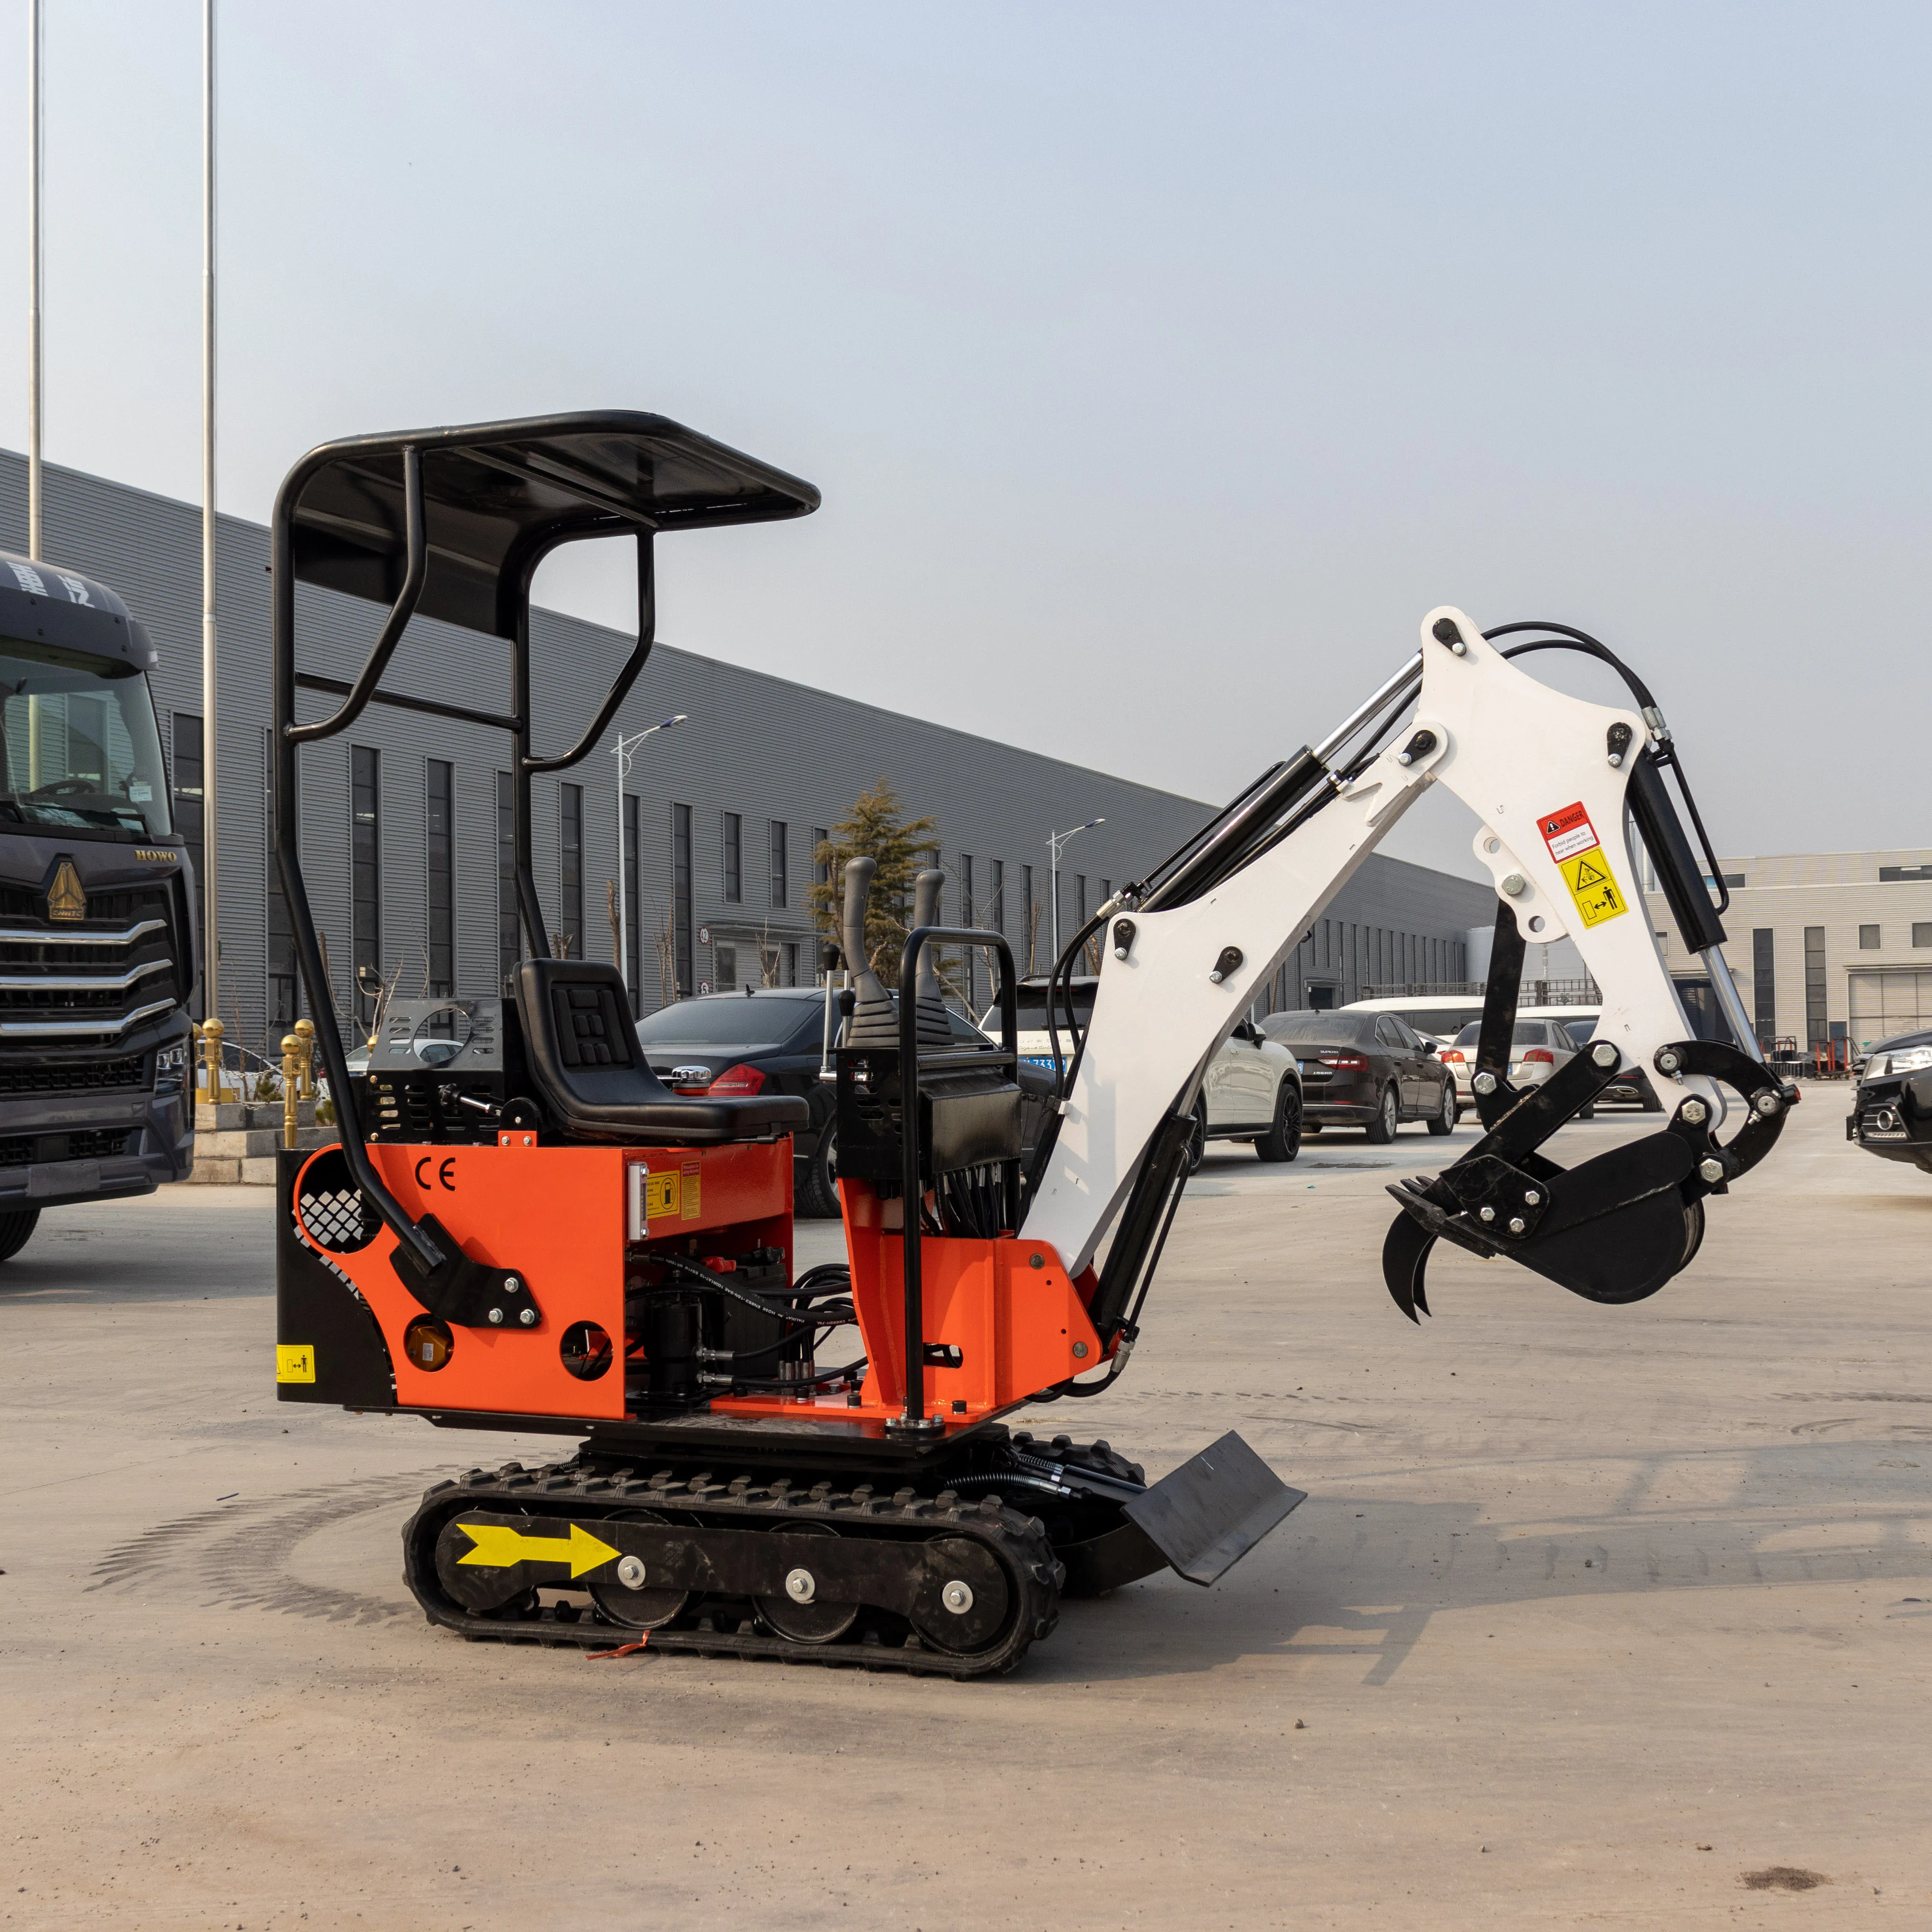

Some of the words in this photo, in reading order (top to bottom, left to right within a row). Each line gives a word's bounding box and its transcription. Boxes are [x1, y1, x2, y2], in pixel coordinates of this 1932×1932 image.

[6, 561, 95, 608] 重汽
[1559, 810, 1584, 826] DANGER
[1552, 840, 1566, 849] Forbid
[1566, 834, 1580, 843] people
[1577, 836, 1594, 846] working
[134, 850, 177, 862] HOWO
[415, 1156, 456, 1191] CE
[762, 1307, 776, 1315] HOSE
